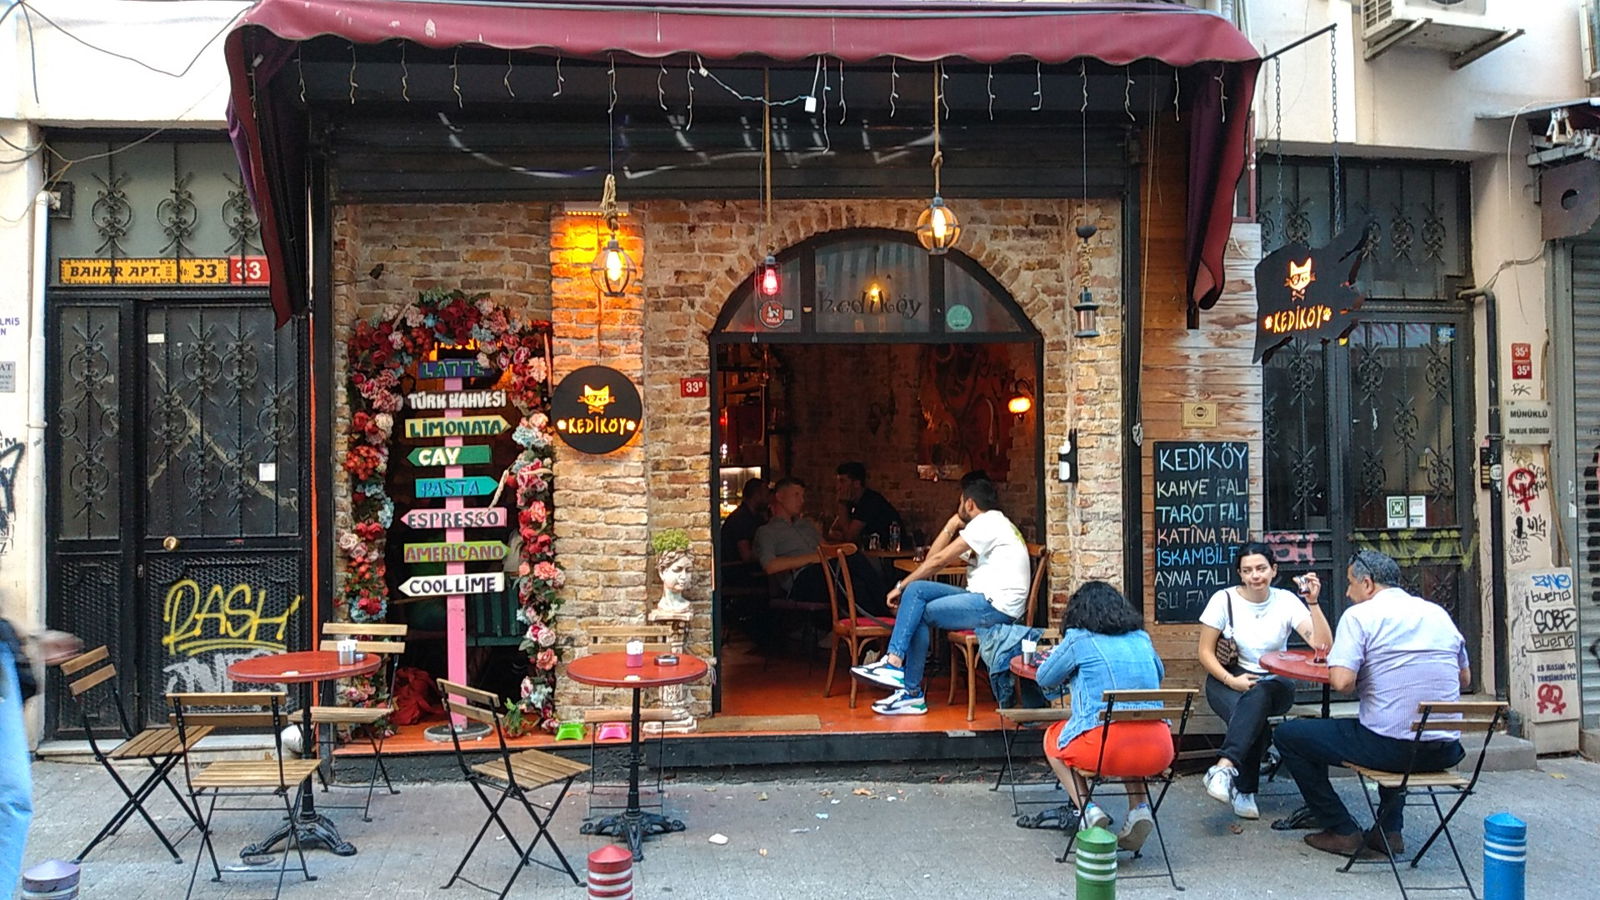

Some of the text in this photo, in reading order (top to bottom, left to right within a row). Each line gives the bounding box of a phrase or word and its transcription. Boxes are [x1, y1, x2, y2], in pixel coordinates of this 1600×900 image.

[70, 265, 123, 278] BAHAR
[128, 265, 161, 278] APT.
[193, 264, 218, 279] 33
[235, 261, 262, 280] 33
[422, 361, 486, 378] LATTE
[407, 388, 507, 409] TÜRK KAHVESİ
[409, 419, 502, 437] LİMONATA
[421, 479, 480, 498] PASTA
[407, 511, 500, 529] ESPRESSO
[1155, 503, 1216, 525] TAROT
[1220, 526, 1250, 545] FALI
[409, 578, 453, 595] COOL
[1154, 567, 1231, 588] AYNA FALI
[1157, 591, 1179, 610] SU
[1533, 608, 1578, 634] SOBE
